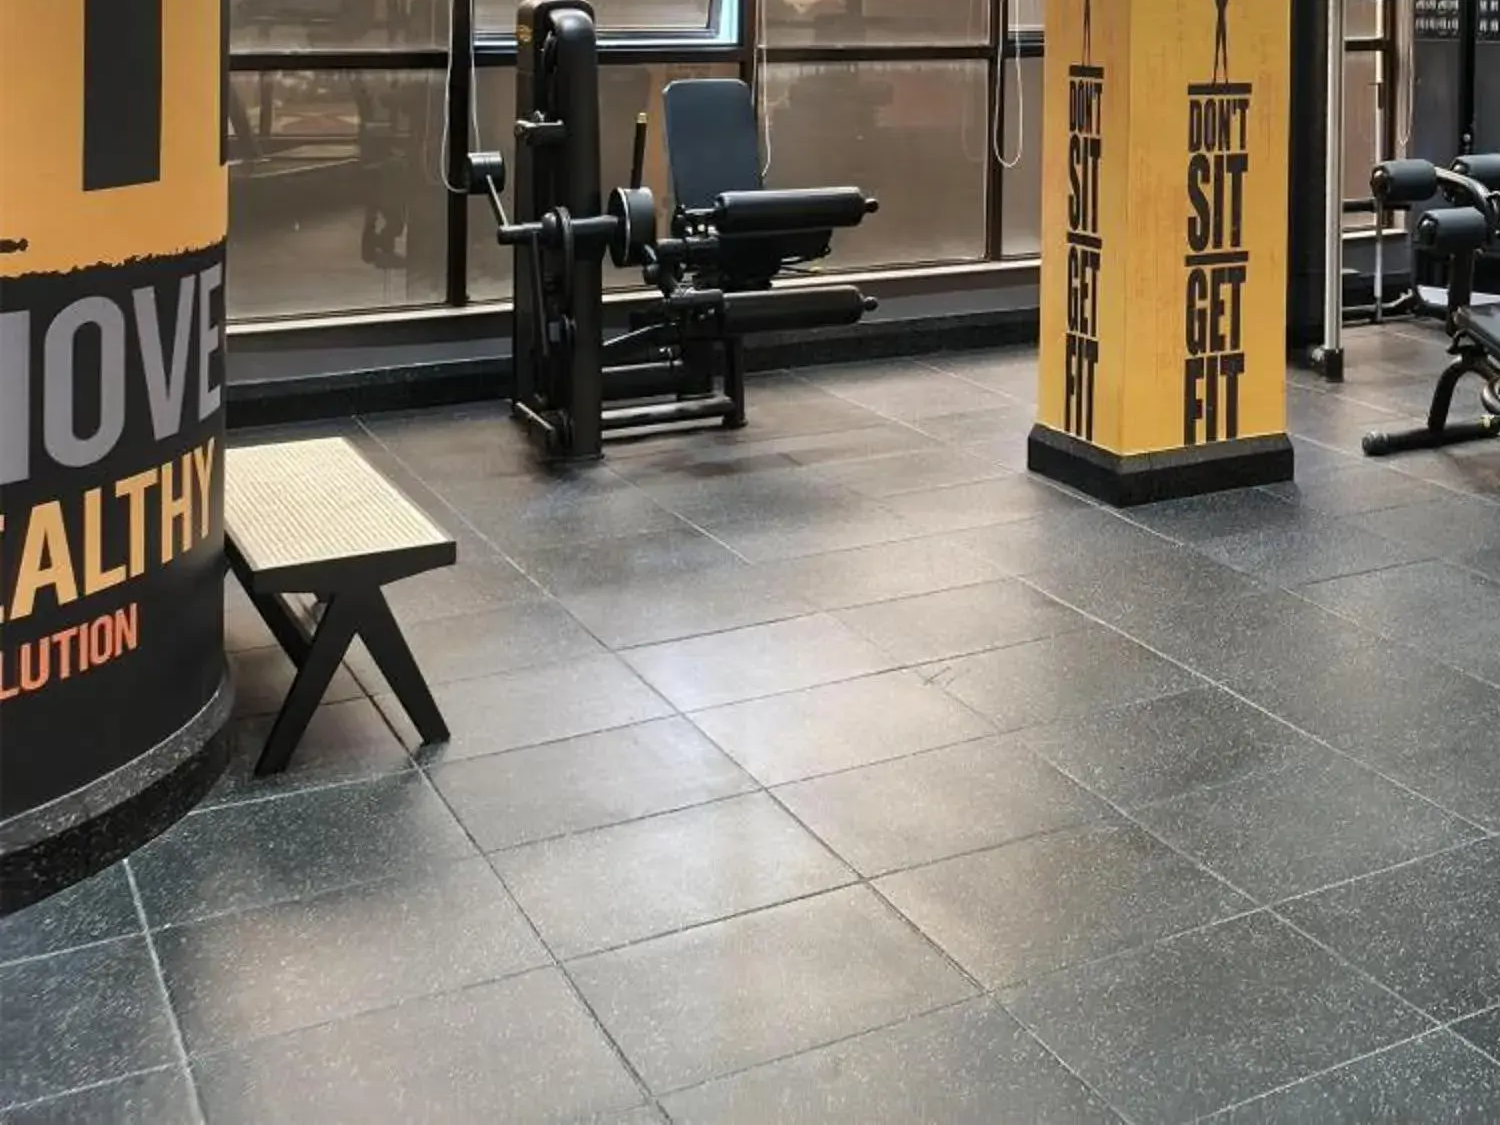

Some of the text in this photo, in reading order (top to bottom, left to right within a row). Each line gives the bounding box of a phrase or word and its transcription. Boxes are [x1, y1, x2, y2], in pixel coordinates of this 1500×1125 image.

[1069, 77, 1102, 137] DON'T
[1187, 95, 1250, 155] DON'T
[1068, 134, 1101, 235] SIT
[1187, 152, 1249, 253] SIT
[1067, 244, 1100, 338] GET
[1185, 265, 1247, 357] GET
[1064, 331, 1098, 444] FIT
[1183, 353, 1245, 446] FIT
[0, 438, 217, 623] ALTHY
